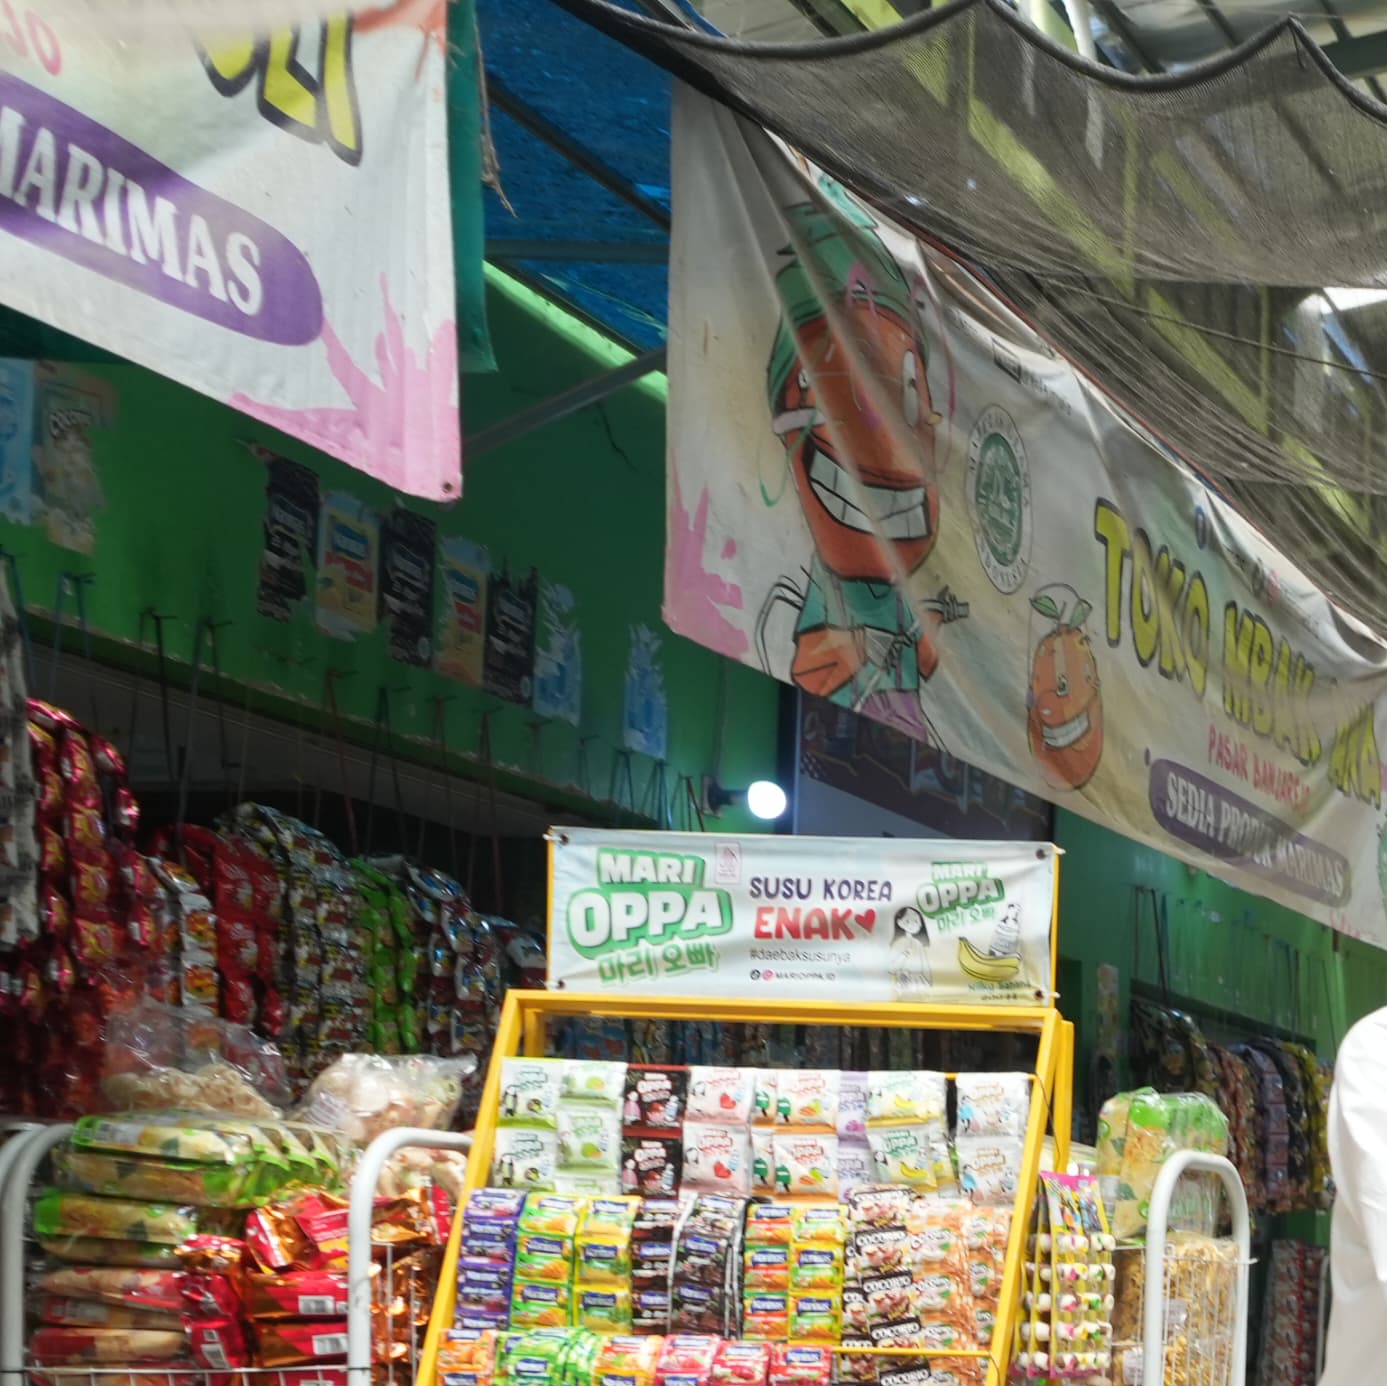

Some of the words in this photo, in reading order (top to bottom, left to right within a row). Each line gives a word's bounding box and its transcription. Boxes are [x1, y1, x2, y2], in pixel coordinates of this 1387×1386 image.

[1094, 497, 1210, 703] TOKO
[1223, 600, 1321, 768] MBAK
[1208, 723, 1248, 782] PASAR
[1166, 771, 1214, 838] SEDIA
[600, 852, 698, 885] MARI
[933, 863, 982, 880] MARI
[750, 877, 812, 900] SUSU
[823, 879, 892, 901] KOREA
[918, 878, 1001, 914] OPPA
[570, 890, 722, 948] OPPA
[754, 906, 855, 940] ENAK
